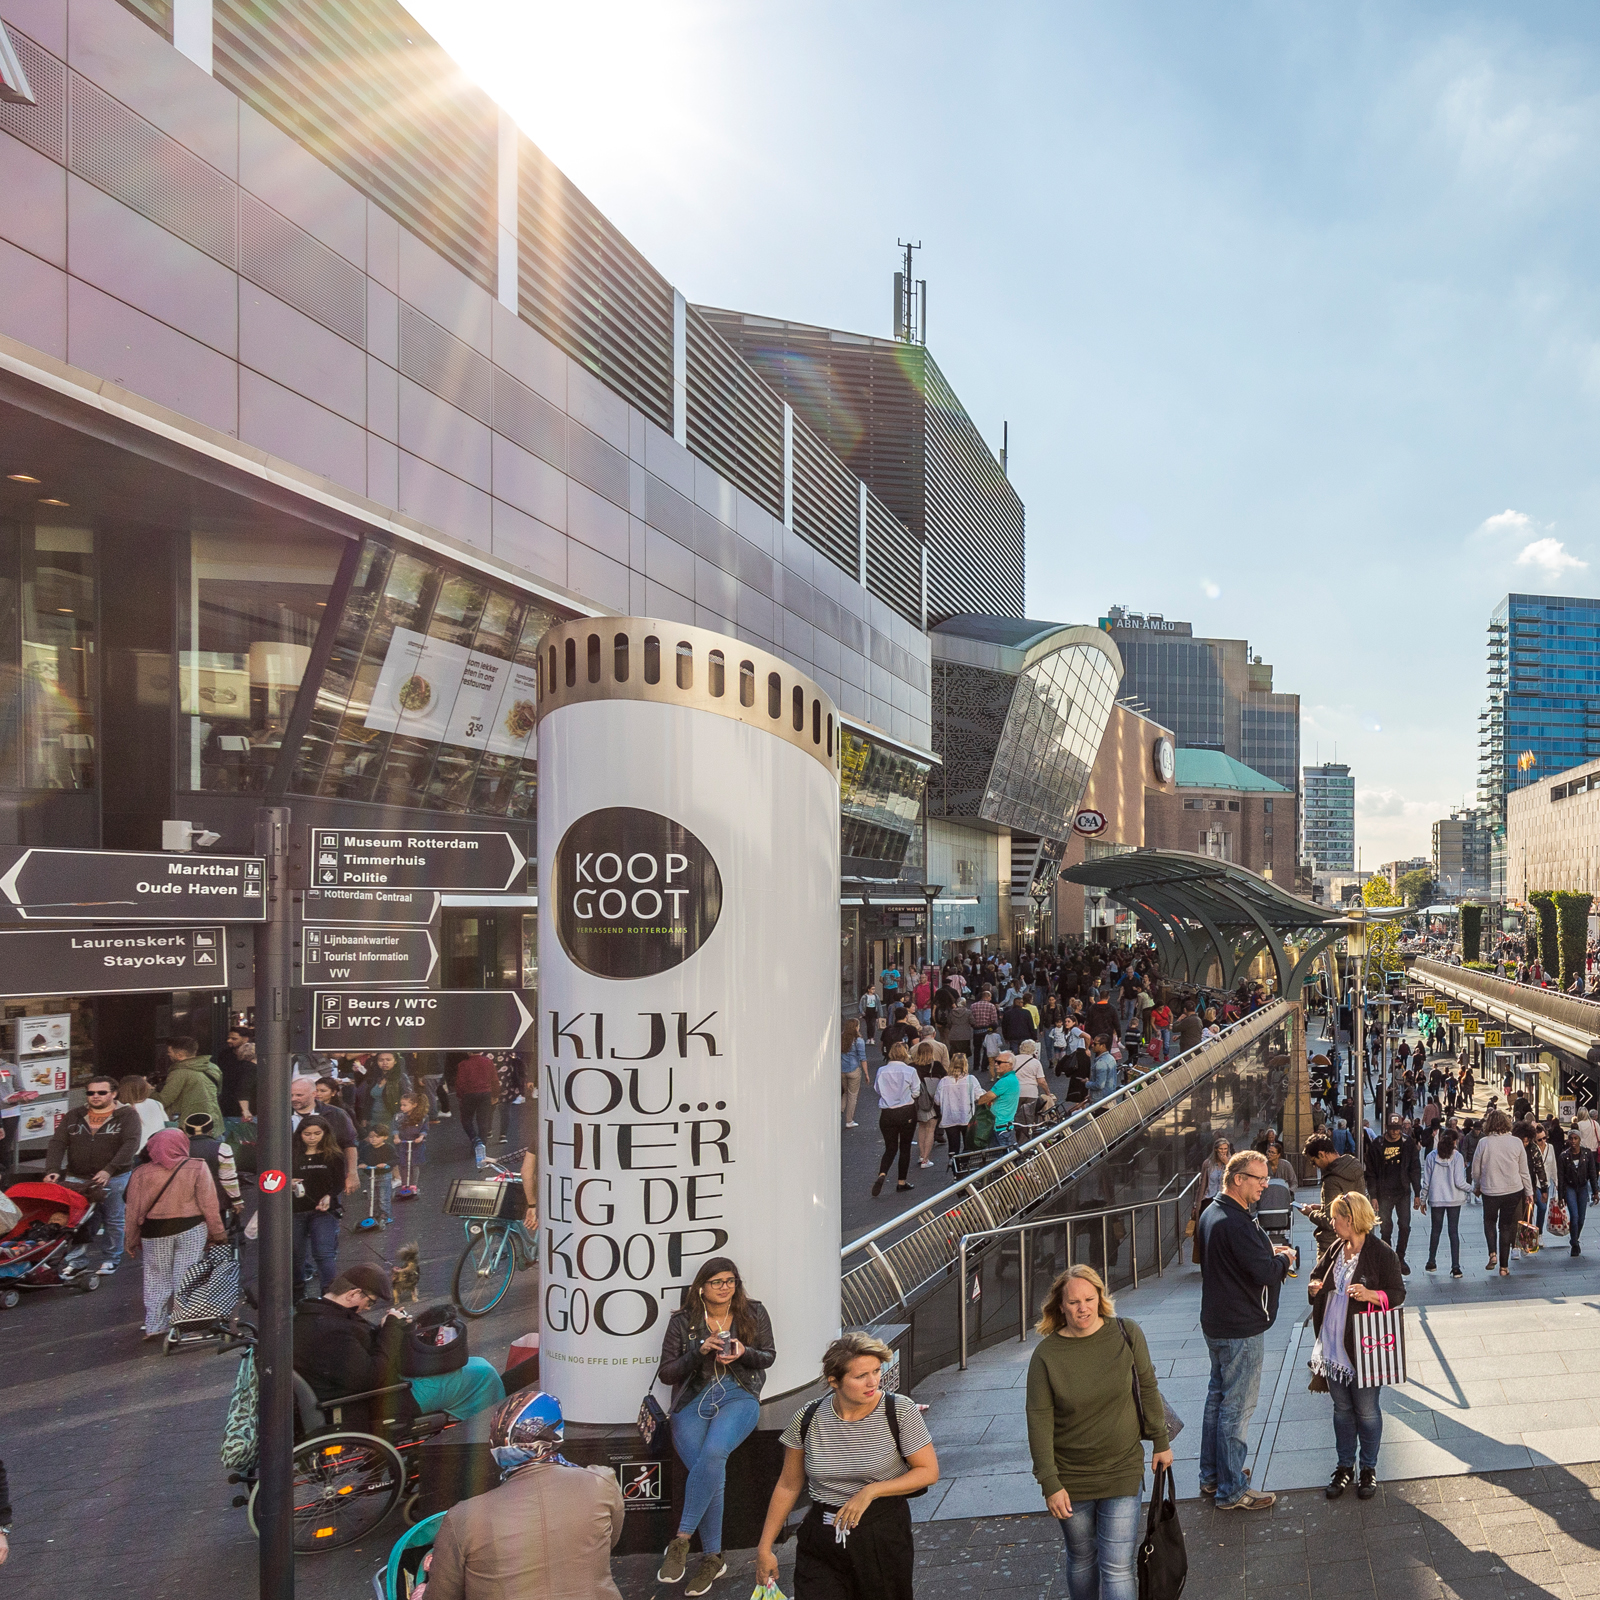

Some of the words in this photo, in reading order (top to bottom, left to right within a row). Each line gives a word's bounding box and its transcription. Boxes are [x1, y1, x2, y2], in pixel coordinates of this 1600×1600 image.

[467, 658, 480, 670] kom
[481, 662, 499, 674] lekker
[478, 671, 483, 679] in
[484, 674, 495, 683] ons
[461, 677, 492, 691] restaurant
[1077, 815, 1099, 828] C&A
[344, 836, 402, 848] Museum
[407, 838, 479, 850] Rotterdam
[343, 854, 426, 866] Timmerhuis
[168, 863, 239, 876] Markthal
[575, 852, 688, 883] KOOP
[343, 872, 388, 883] Politie
[136, 882, 182, 894] Oude
[188, 883, 238, 895] Haven
[324, 890, 373, 901] Rotterdam
[376, 892, 412, 902] Centraal
[573, 888, 689, 919] GOOT
[576, 926, 624, 934] VERRASSEND
[627, 926, 688, 934] ROTTERDAMS
[71, 936, 185, 949] Laurenskerk
[324, 935, 399, 947] Lijnbaankwartier
[103, 952, 186, 969] Stayokay
[324, 952, 357, 961] Tourist
[359, 952, 409, 961] Information
[330, 968, 350, 978] VVV
[348, 999, 390, 1009] Beurs
[394, 998, 400, 1009] /
[404, 999, 437, 1009] WTC
[1436, 1003, 1447, 1011] F21
[1450, 1010, 1462, 1020] F21
[348, 1016, 381, 1027] WTC
[385, 1016, 391, 1027] /
[395, 1016, 425, 1027] V&D
[1465, 1019, 1478, 1029] F21
[548, 1011, 723, 1060] KIJK
[1486, 1032, 1499, 1042] F21
[545, 1064, 727, 1115] NOU...
[544, 1118, 736, 1170] HIER
[546, 1174, 615, 1227] LEG
[639, 1173, 724, 1225] DE
[545, 1227, 729, 1282] KOOP
[568, 1356, 584, 1364] NOG
